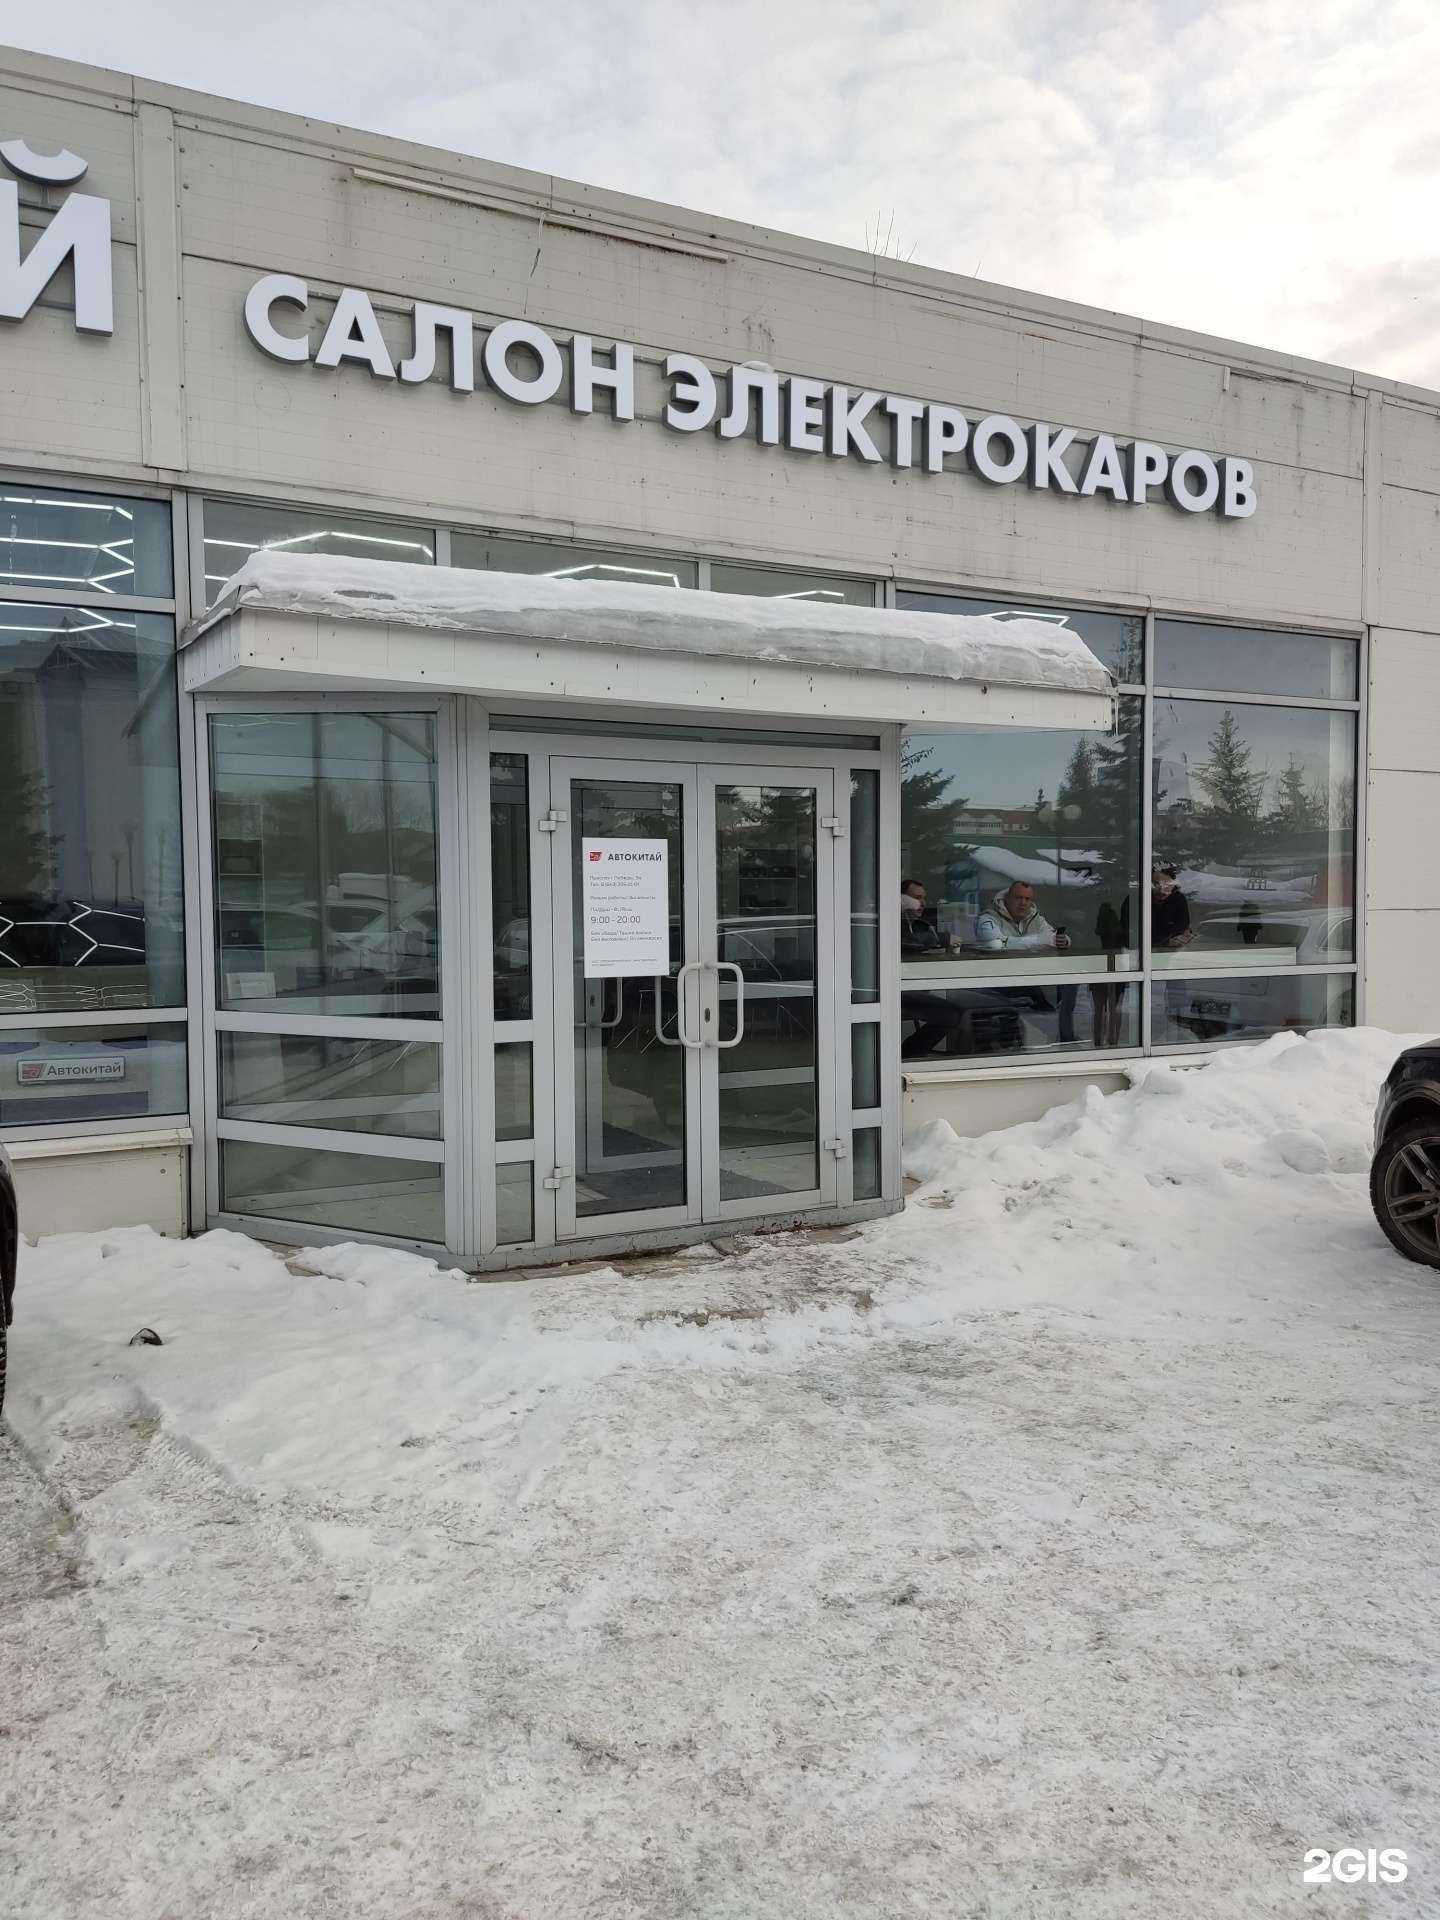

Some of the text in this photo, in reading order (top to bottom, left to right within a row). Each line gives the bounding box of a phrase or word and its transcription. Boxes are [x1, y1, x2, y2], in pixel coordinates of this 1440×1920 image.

[244, 274, 1258, 519] САЛОН ЭЛЕКТРОКАРОВ
[607, 852, 662, 862] АВТОКИТАЙ
[590, 915, 610, 924] 9:00
[616, 915, 641, 924] 20:00
[47, 1062, 121, 1076] Автокитай
